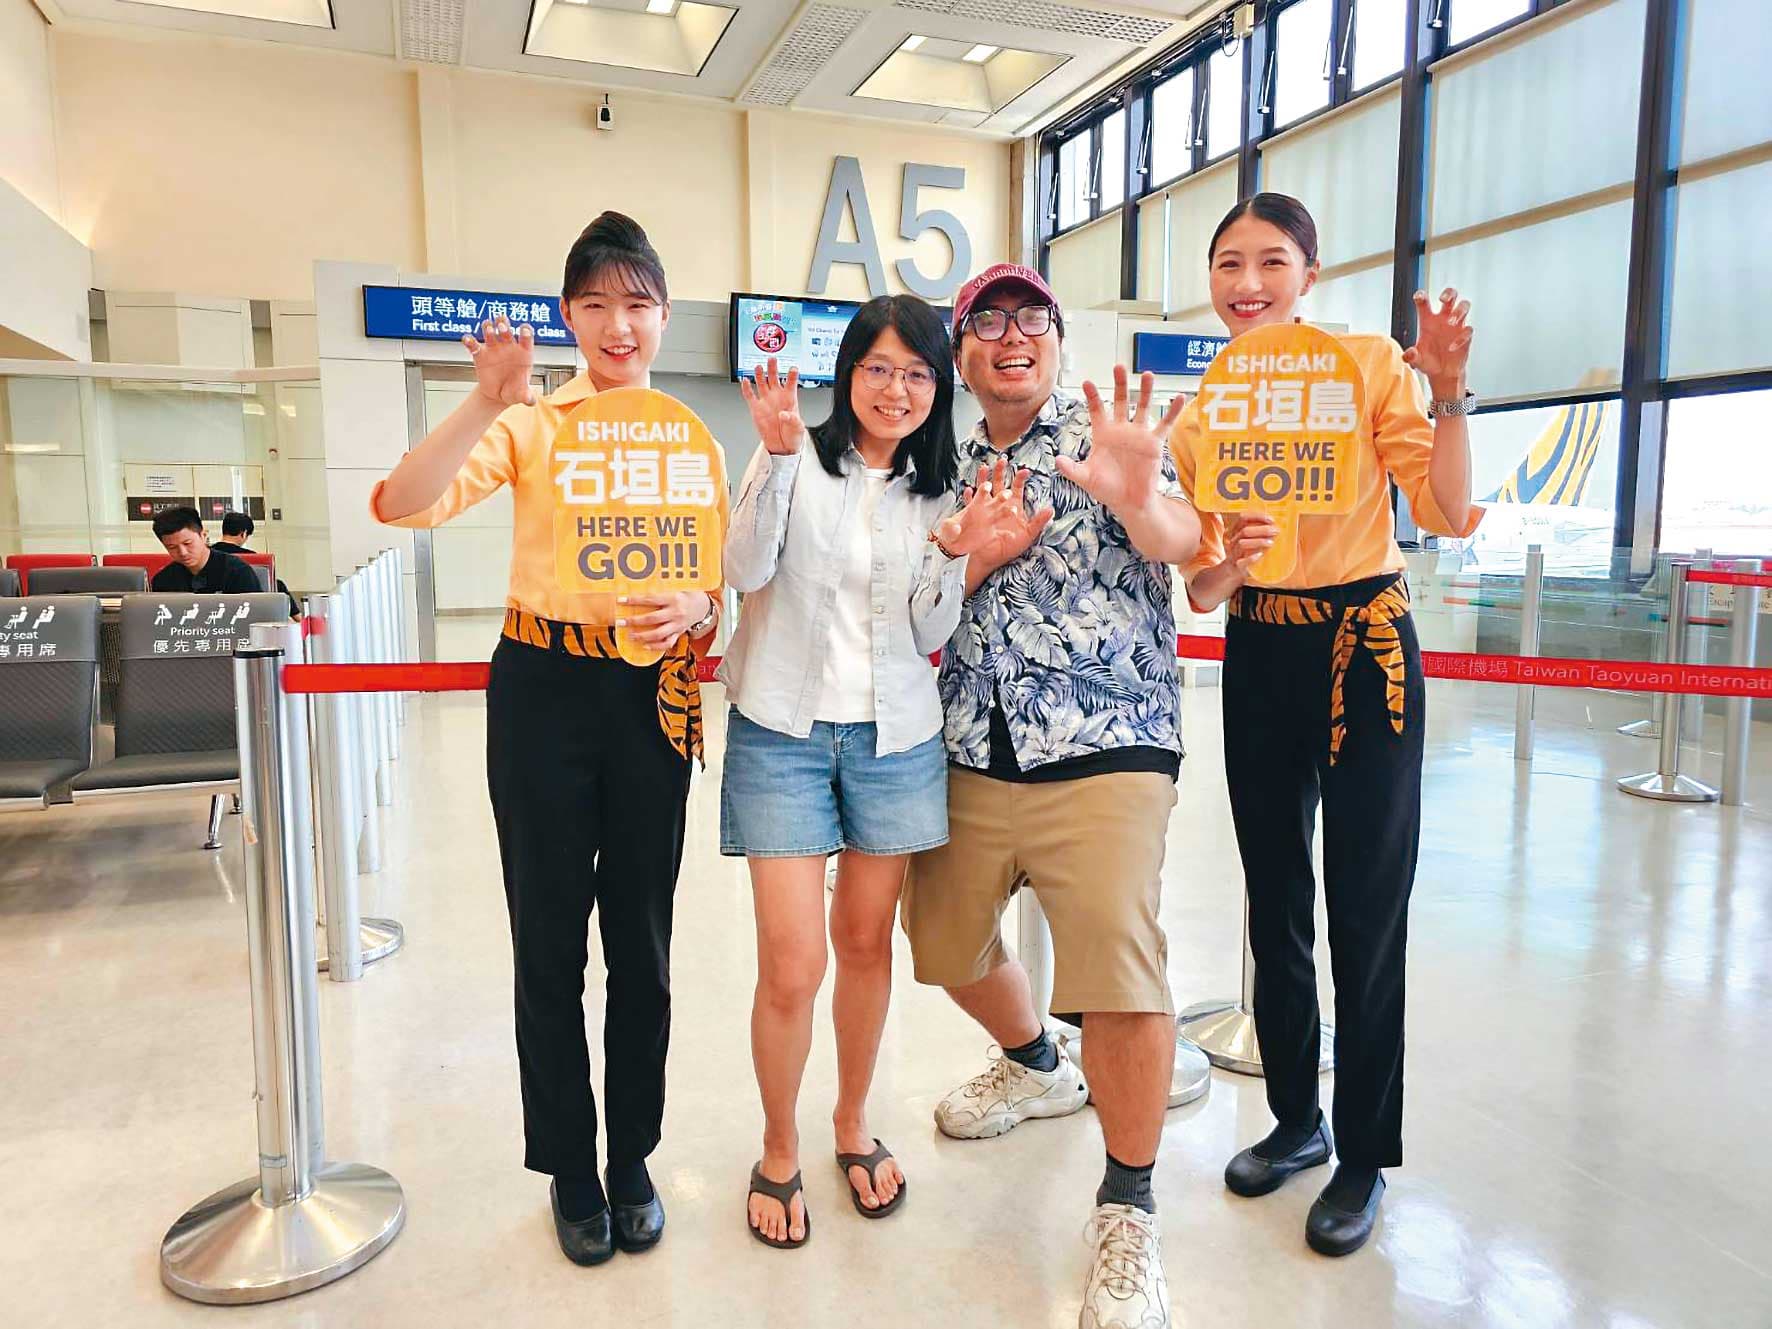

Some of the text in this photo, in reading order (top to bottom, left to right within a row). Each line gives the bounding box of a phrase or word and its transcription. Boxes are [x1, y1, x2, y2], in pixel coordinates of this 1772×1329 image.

[806, 155, 972, 300] A5
[411, 296, 550, 322] 頭等艙/商務艙
[412, 319, 440, 332] First
[442, 320, 472, 333] class
[537, 325, 566, 338] class
[1228, 353, 1336, 373] ISHIGAKI
[1203, 379, 1357, 432] 石垣島
[577, 421, 689, 442] ISHIGAKI
[1219, 442, 1335, 461] HERE WE
[555, 447, 714, 505] 石垣島
[1216, 466, 1335, 501] GO!!!
[577, 516, 697, 537] HERE WE
[578, 543, 698, 580] GO!!!
[12, 631, 39, 640] seat
[171, 626, 236, 638] Priority seat
[1422, 655, 1508, 678] 國際機場
[1514, 661, 1580, 680] Taiwan
[1587, 665, 1672, 686] Taoyuan
